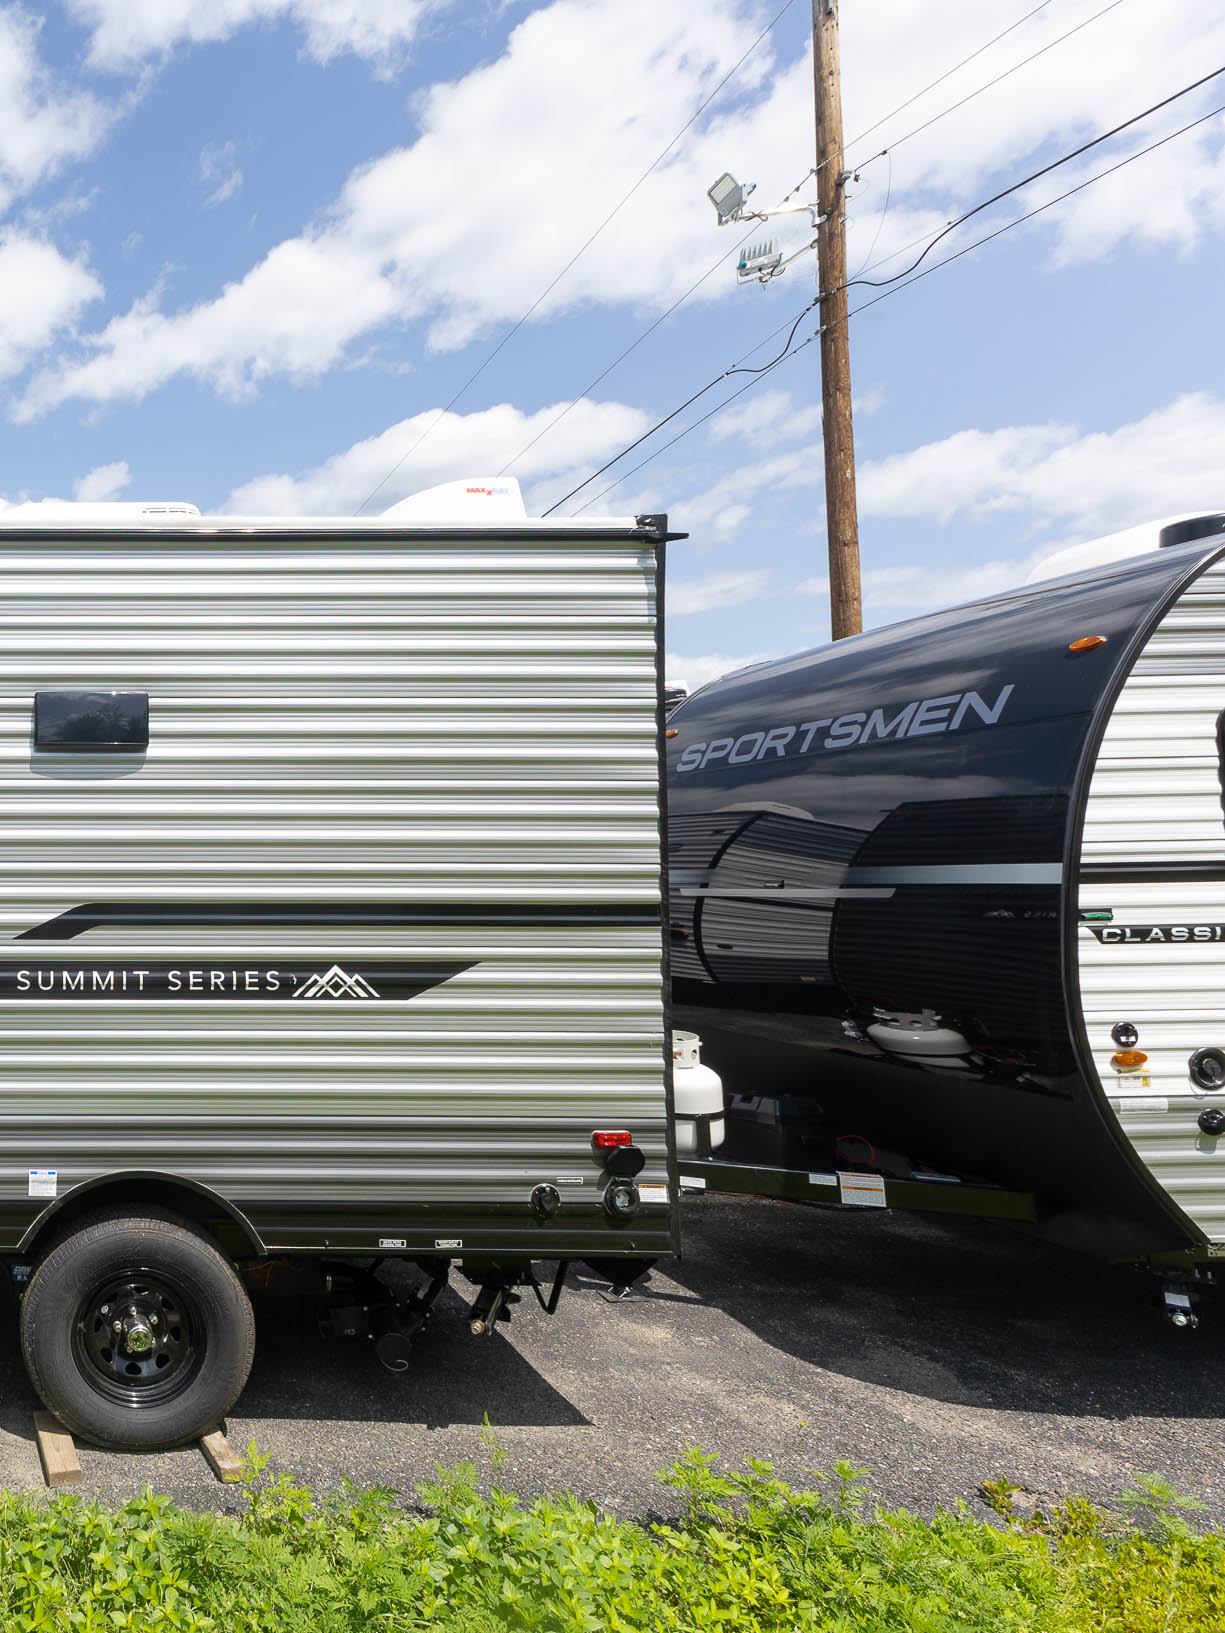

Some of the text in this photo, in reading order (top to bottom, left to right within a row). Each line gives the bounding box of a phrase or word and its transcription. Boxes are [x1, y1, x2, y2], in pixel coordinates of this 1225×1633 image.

[676, 684, 1015, 773] SPORTSMEN
[16, 970, 281, 991] SUMMIT SERIES
